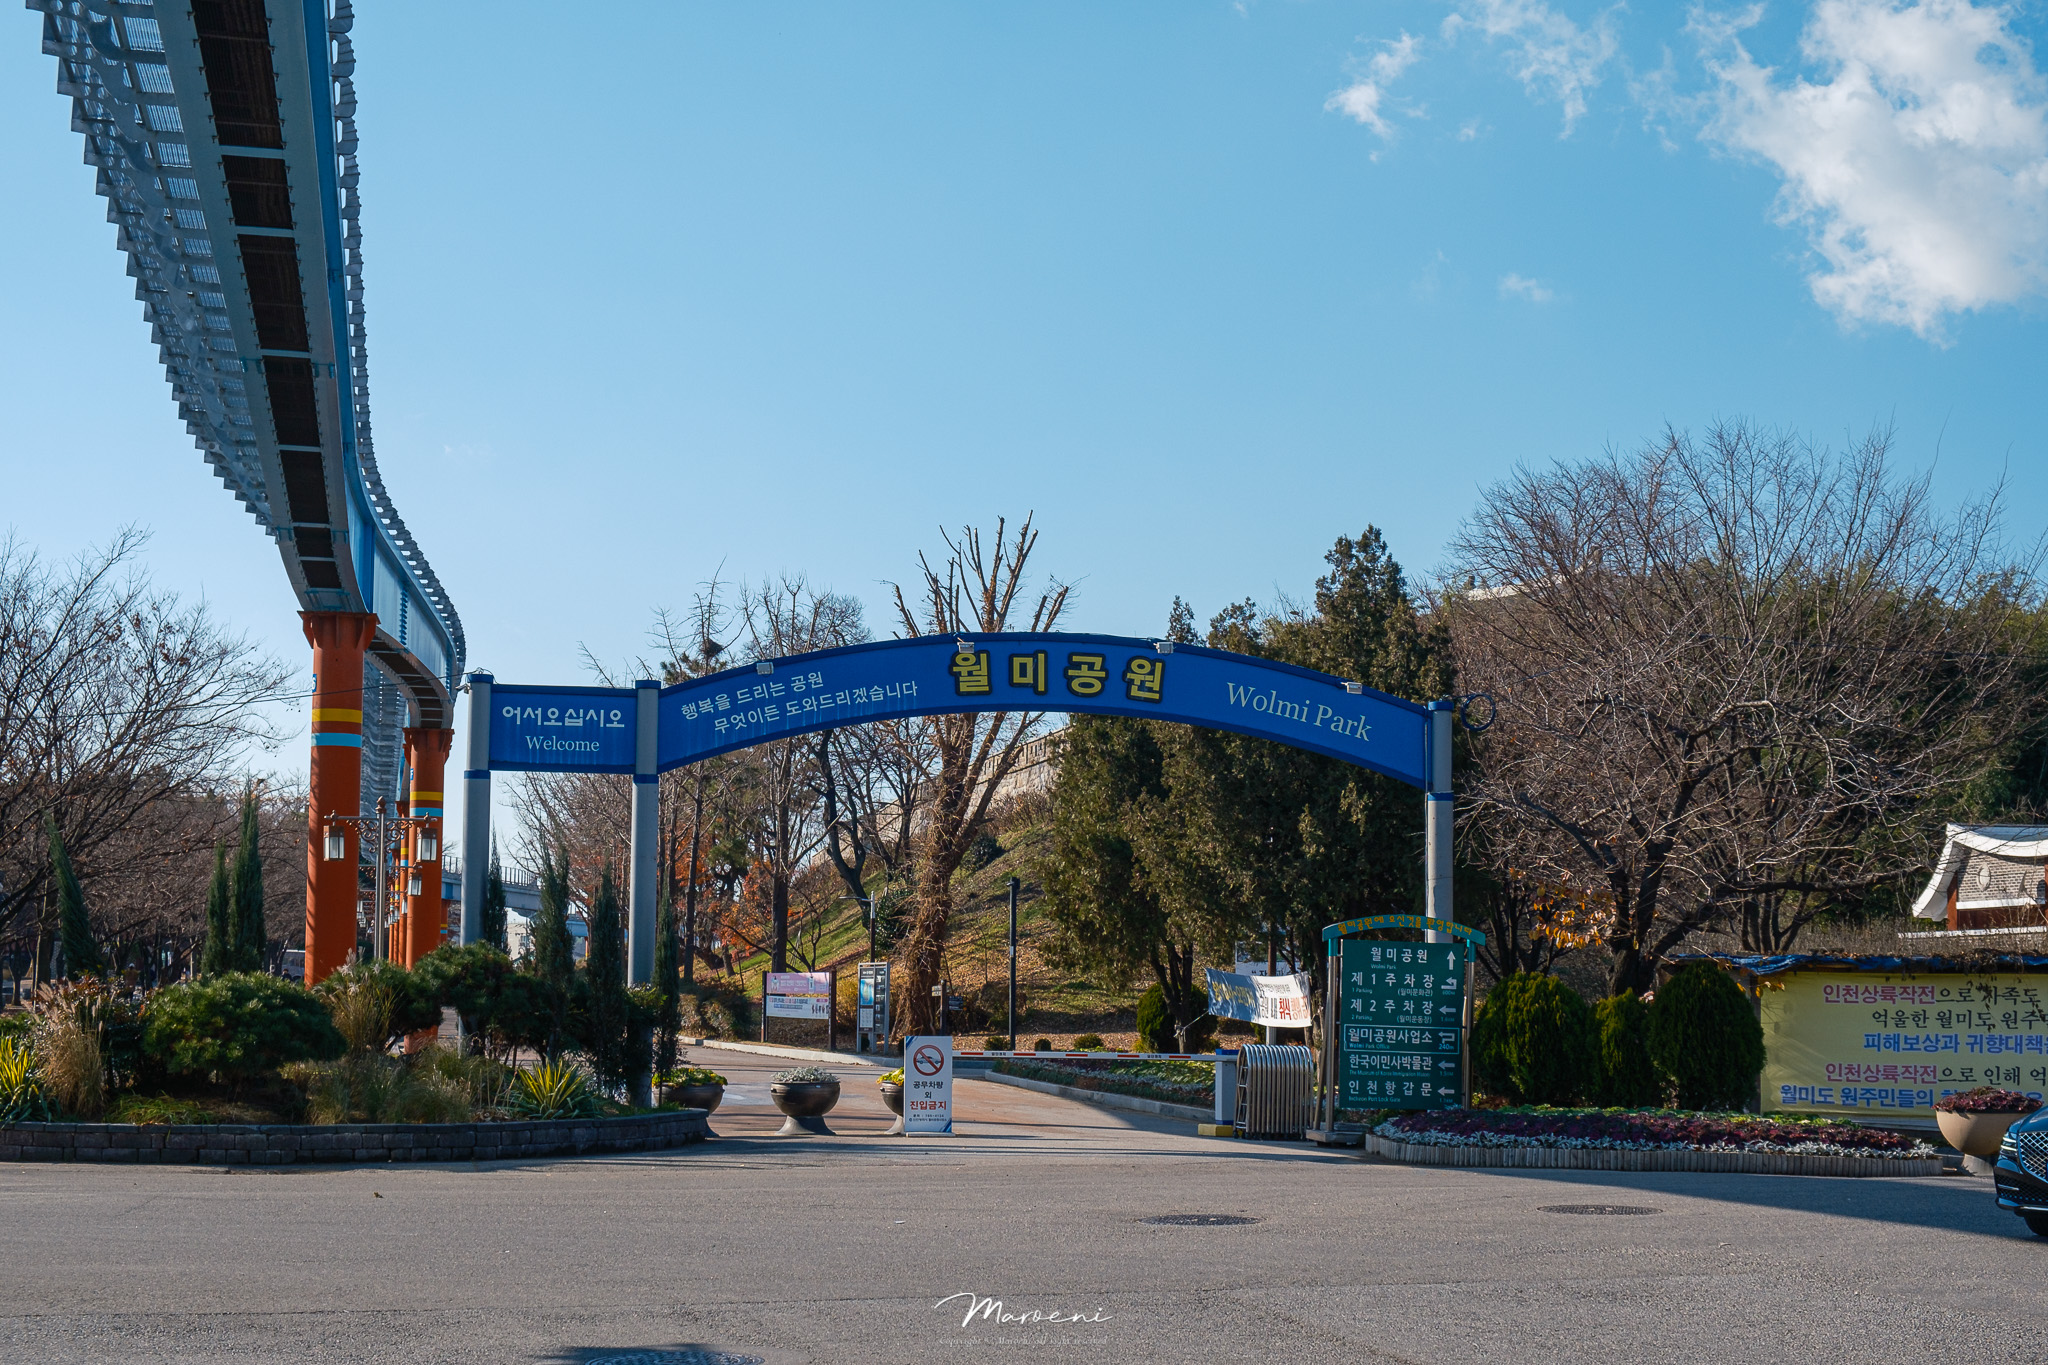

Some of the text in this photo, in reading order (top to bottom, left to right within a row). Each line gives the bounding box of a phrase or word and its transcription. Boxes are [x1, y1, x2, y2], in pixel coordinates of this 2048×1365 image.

[951, 651, 1163, 701] 월미공원
[680, 671, 824, 721] 행복을 드리는 공원
[501, 705, 625, 728] 어서오십시오
[714, 680, 918, 735] 무엇이든 도와드리겠습니다
[1227, 681, 1373, 742] Wolmi Park
[525, 735, 600, 752] Welcome
[1337, 915, 1384, 935] 월미공원에
[1426, 917, 1472, 935] 환영합니다
[1370, 946, 1428, 964] 월미공원
[1822, 983, 1976, 1005] 인천상륙작전으로
[1872, 1008, 1930, 1029] 억울한
[1935, 1009, 1993, 1029] 월미도
[1348, 1028, 1433, 1044] 월미공원사업소
[1863, 1032, 1960, 1053] 피해보상과
[1349, 1054, 1433, 1071] 한국이민사박물관
[1825, 1063, 1978, 1085] 인천상륙작전으로
[1984, 1065, 2021, 1086] 인해
[912, 1081, 944, 1090] 공무차량
[924, 1091, 932, 1100] 외
[1780, 1084, 1835, 1105] 월미도
[1839, 1086, 1934, 1108] 원주민들의
[910, 1100, 947, 1111] 진입금지
